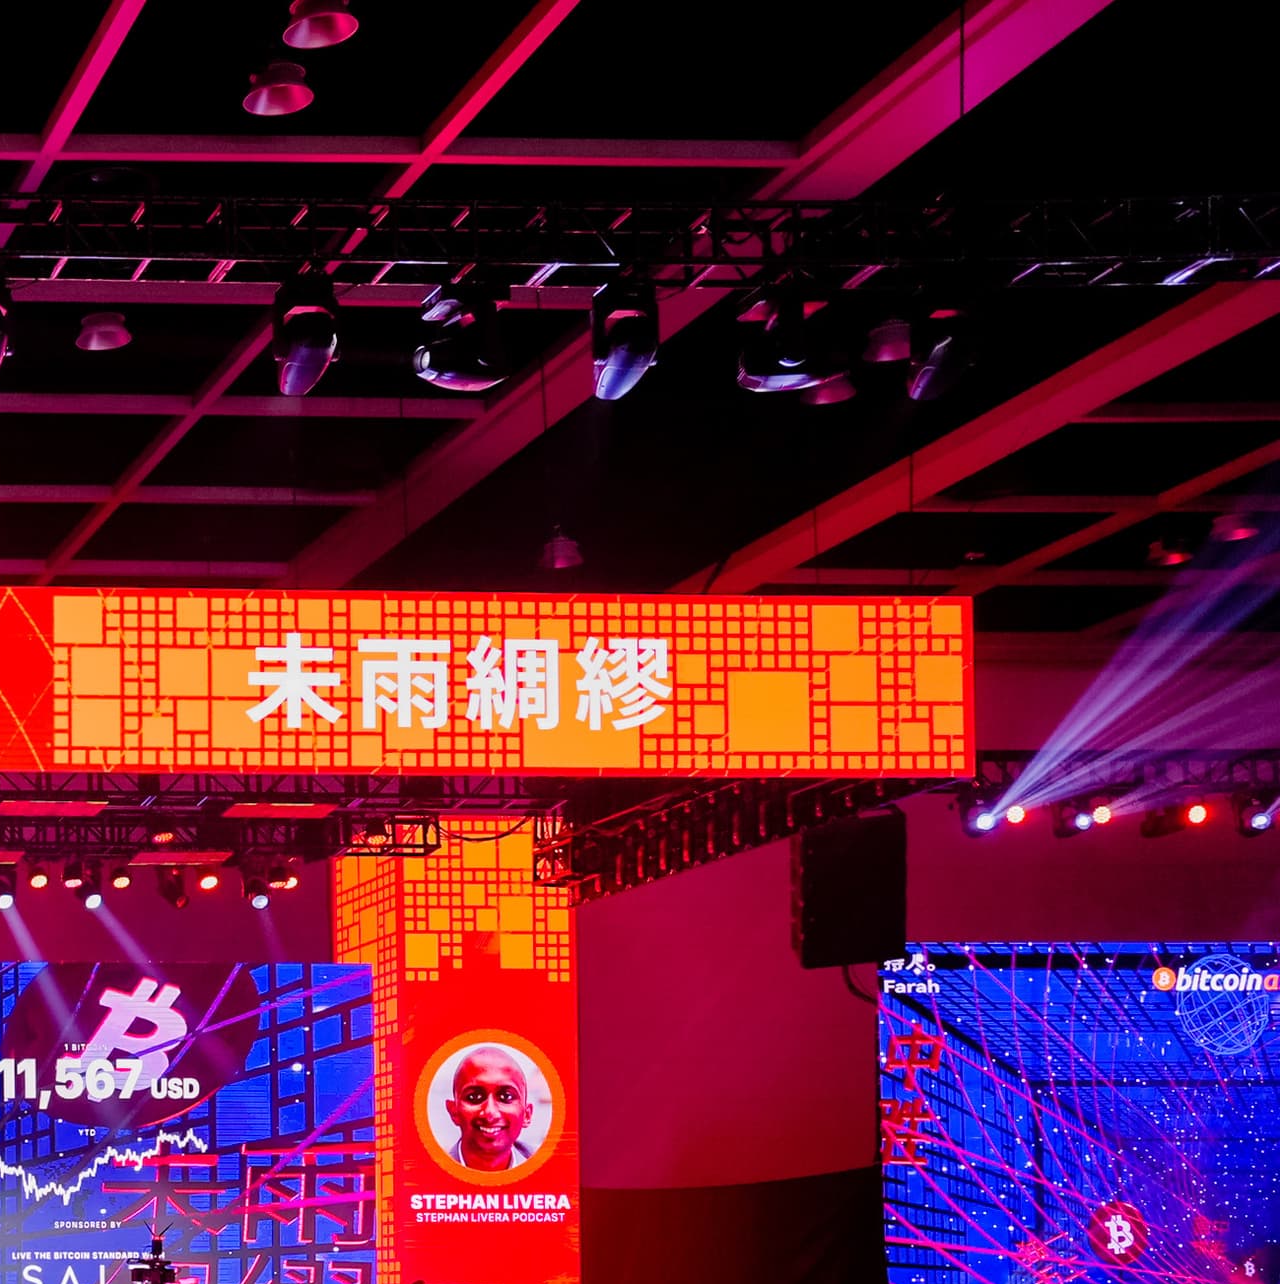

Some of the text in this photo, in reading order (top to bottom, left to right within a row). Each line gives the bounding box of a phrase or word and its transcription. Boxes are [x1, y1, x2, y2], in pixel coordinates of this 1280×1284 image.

[245, 632, 672, 730] 未雨綢繆
[883, 979, 940, 994] Farah
[150, 1078, 200, 1099] USD
[78, 1129, 96, 1137] YTD
[410, 1194, 571, 1209] STEPHAN LIVERA
[416, 1212, 565, 1223] STEPHAN LIVERA PODCAST
[54, 1221, 122, 1229] SPONSORED BY
[12, 1252, 31, 1260] LIVE
[34, 1252, 51, 1260] THE
[53, 1252, 90, 1260] BITCOIN
[92, 1252, 139, 1260] STANDARD
